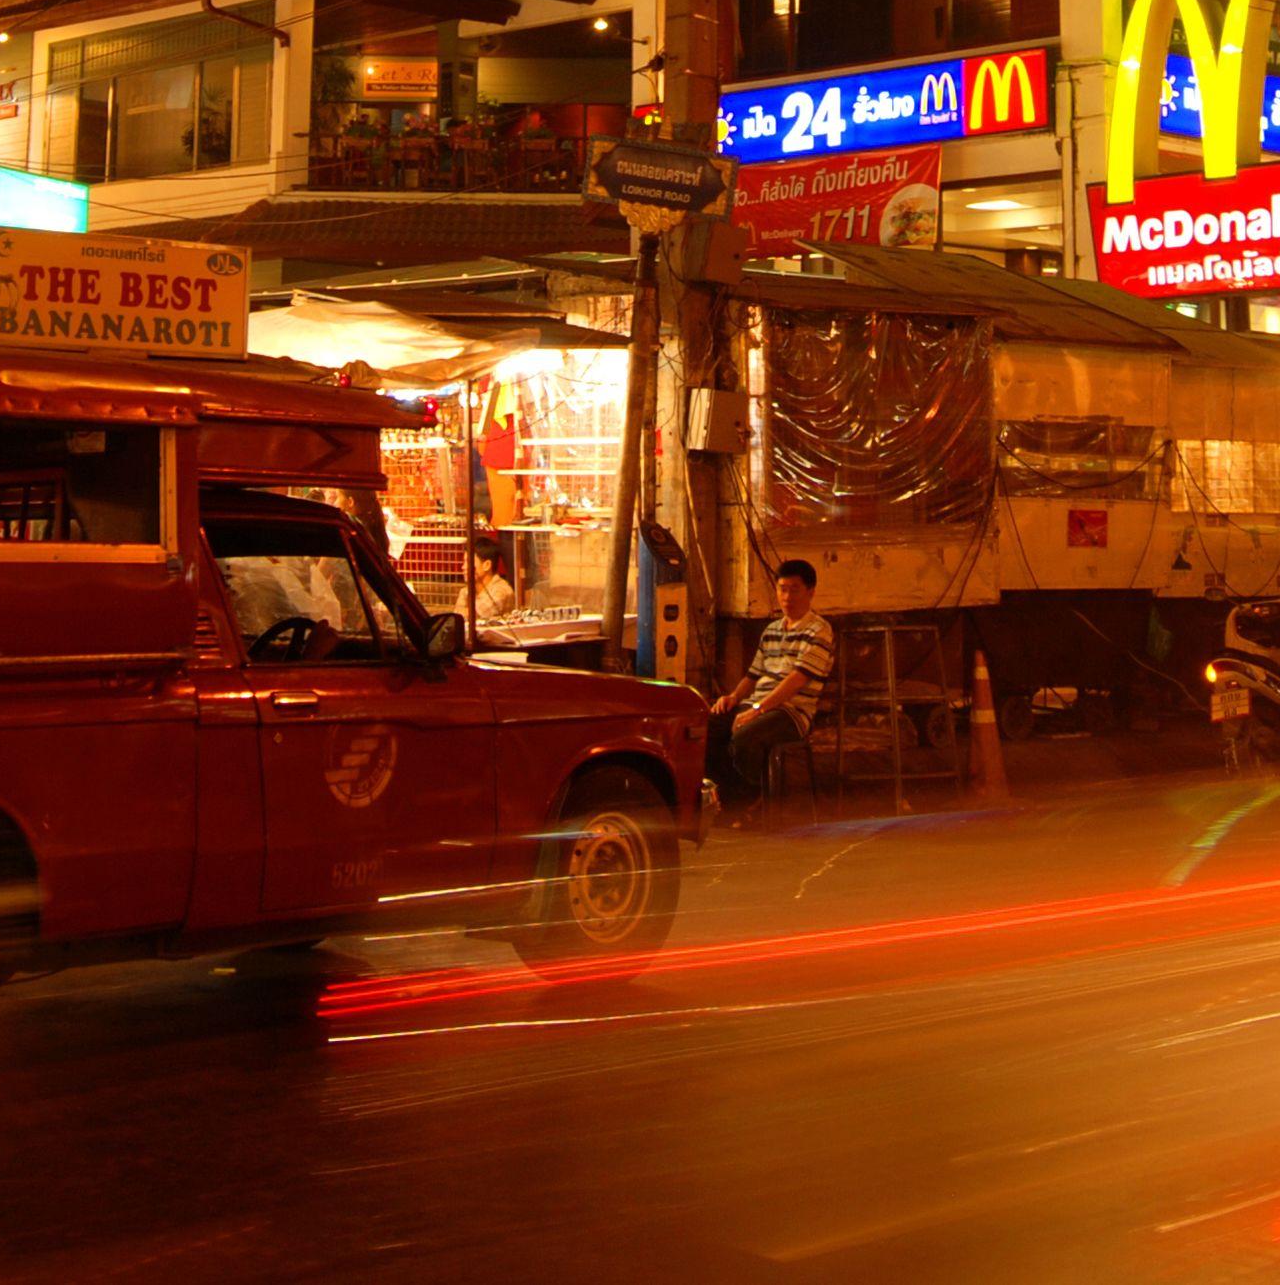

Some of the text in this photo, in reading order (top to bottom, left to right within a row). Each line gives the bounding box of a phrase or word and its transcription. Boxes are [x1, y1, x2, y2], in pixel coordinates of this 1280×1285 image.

[782, 86, 847, 153] 24
[664, 191, 691, 203] ROAD
[760, 202, 872, 242] McDelivery 1711
[20, 264, 218, 313] THE BEST
